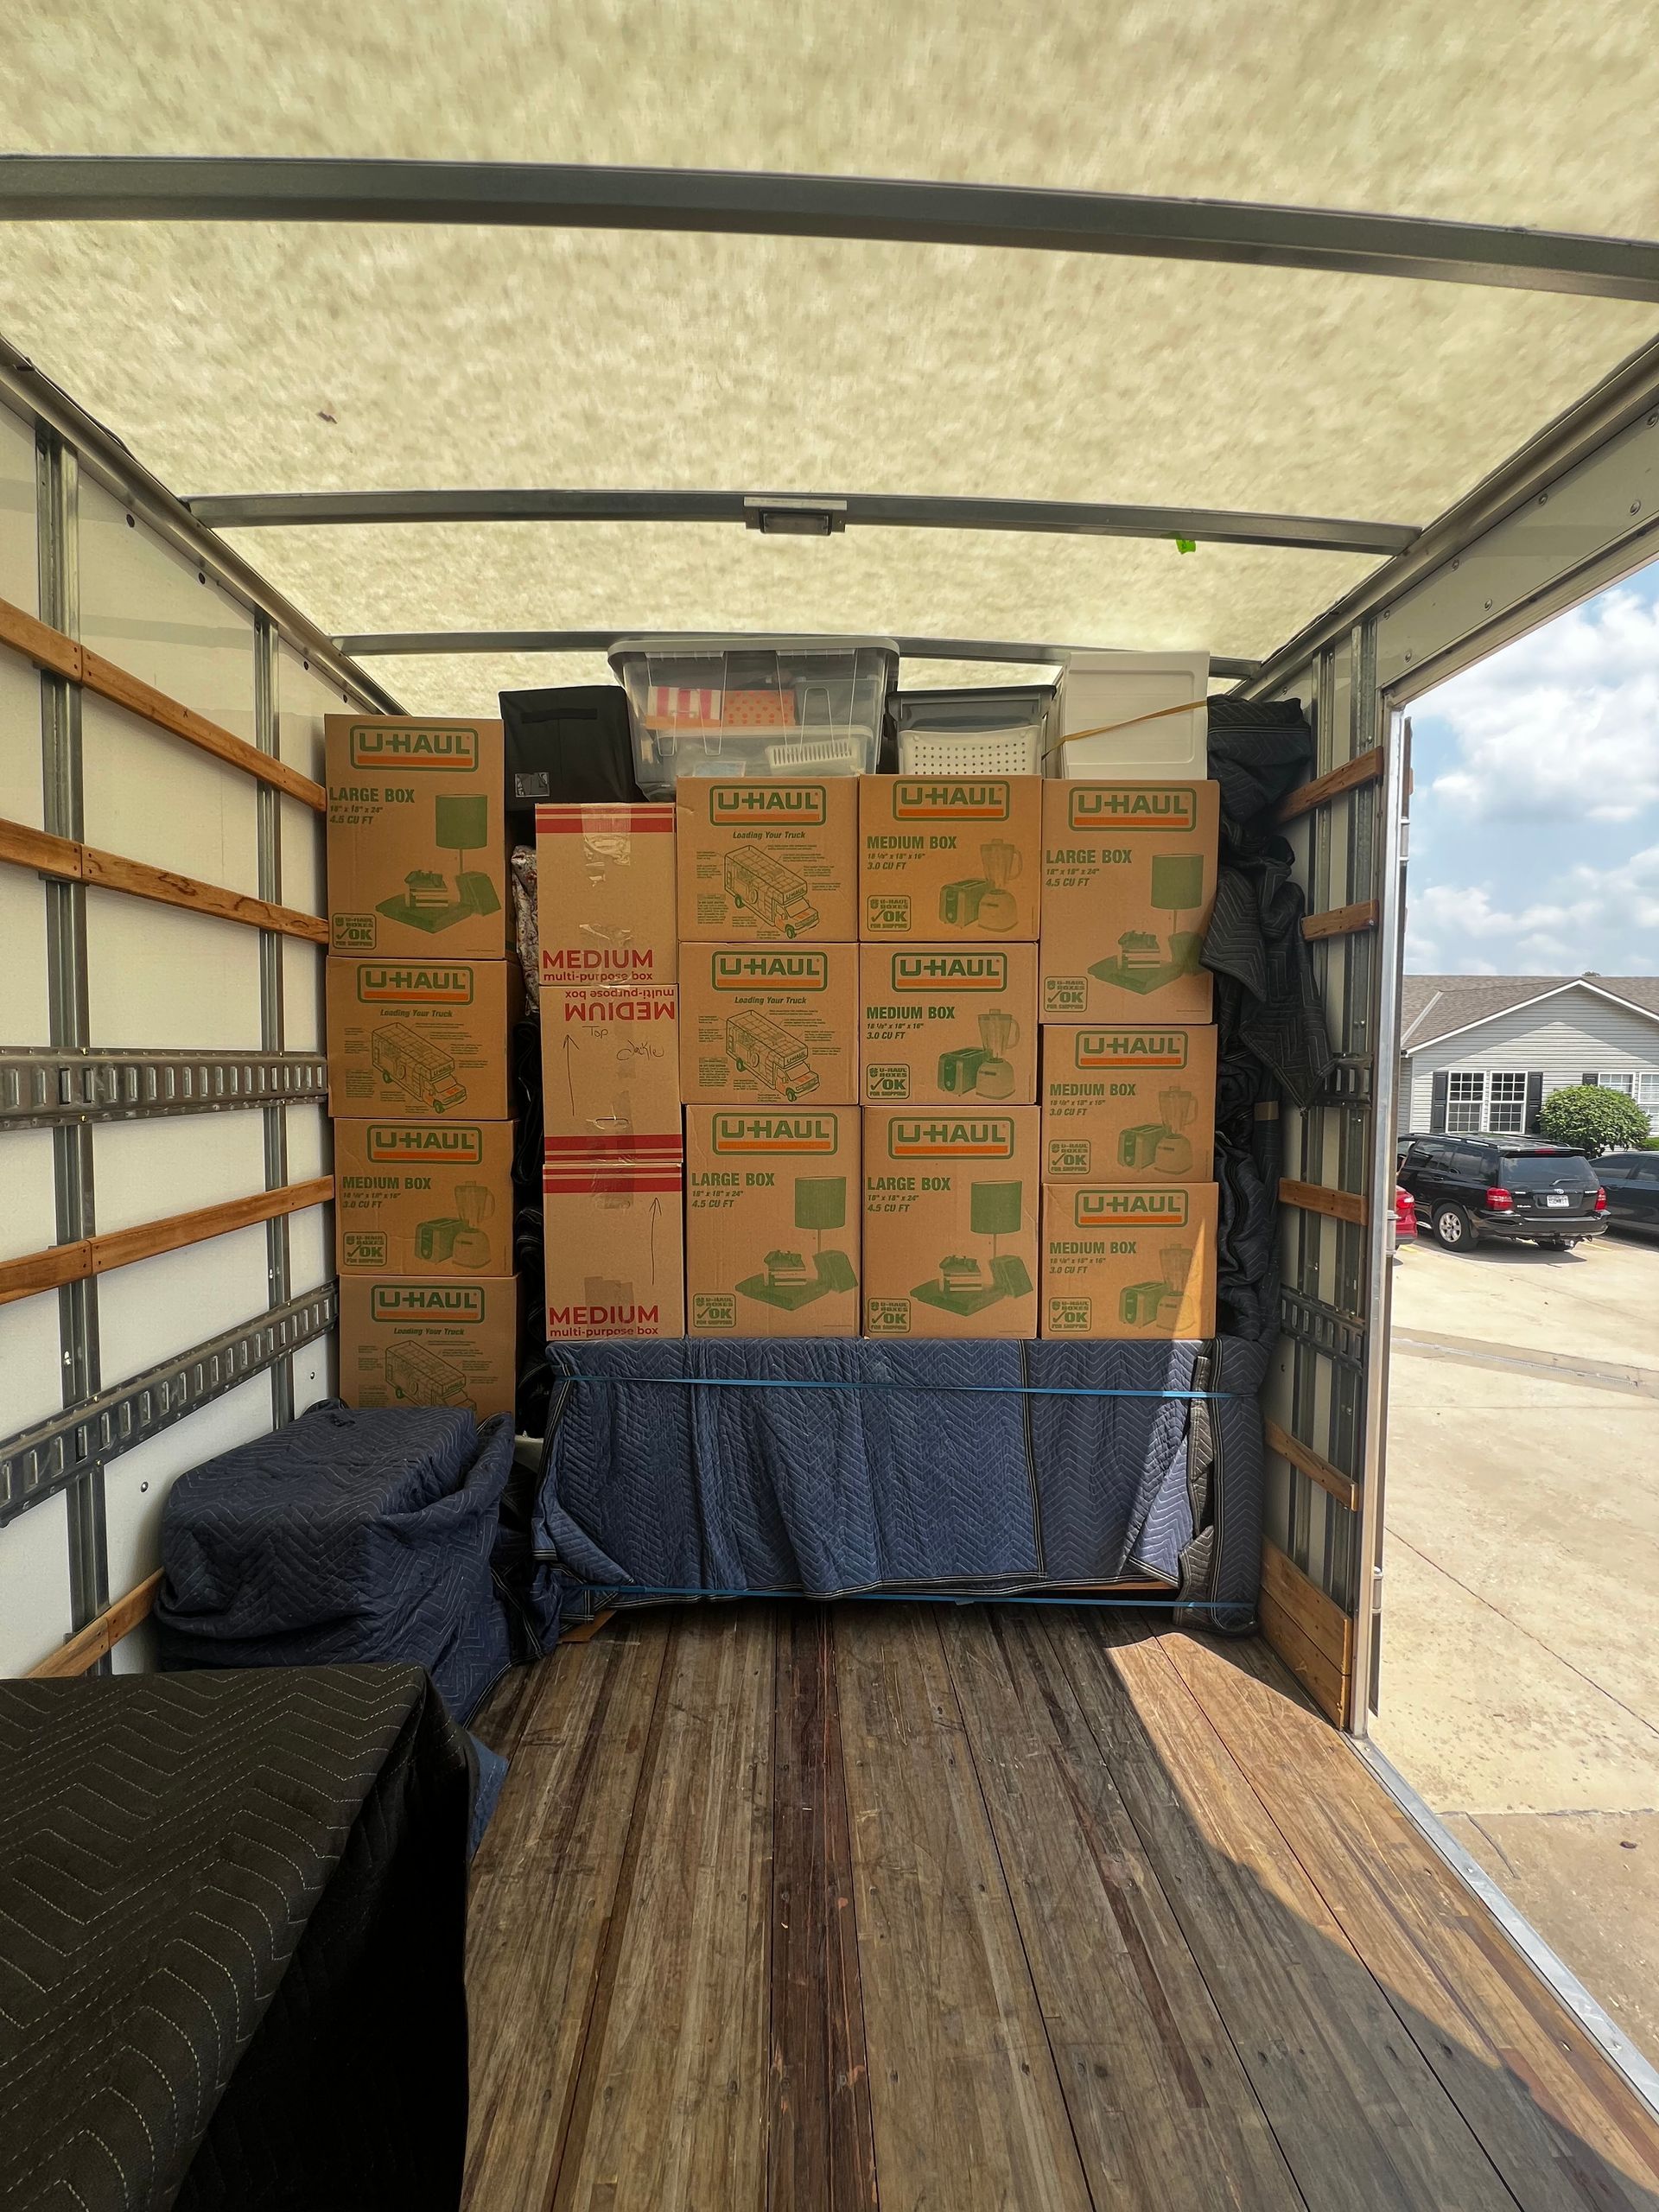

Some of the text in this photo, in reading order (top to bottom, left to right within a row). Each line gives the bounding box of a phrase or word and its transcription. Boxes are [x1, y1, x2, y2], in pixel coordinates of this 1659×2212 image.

[359, 733, 471, 755] U-HAUL
[329, 787, 415, 804] LARGE BOX
[718, 792, 818, 810] U-HAUL
[901, 787, 1002, 805] U-HAUL
[1077, 794, 1189, 814] U-HAUL
[733, 831, 762, 840] Loading
[867, 836, 957, 849] MEDIUM BOX
[1046, 849, 1132, 864] LARGE BOX
[1046, 878, 1090, 887] 4.5 CU FT
[883, 911, 906, 922] OK
[348, 929, 372, 941] OK
[543, 950, 653, 969] MEDIUM
[720, 958, 820, 976] U-HAUL
[899, 959, 1000, 976] U-HAUL
[365, 971, 466, 989] U-HAUL
[543, 971, 653, 982] multi-purpose box
[565, 988, 674, 1000] multi-purpose box
[734, 996, 764, 1005] Loading
[1059, 992, 1084, 1002] OK
[564, 1001, 675, 1021] MEDIUM
[867, 1007, 955, 1020] MEDIUM BOX
[1084, 1038, 1180, 1054] U-HAUL
[882, 1079, 906, 1090] OK
[1050, 1084, 1136, 1096] MEDIUM BOX
[721, 1120, 830, 1139] U-HAUL
[898, 1124, 1006, 1142] U-HAUL
[375, 1132, 474, 1149] U-HAUL
[1064, 1154, 1087, 1166] OK
[343, 1177, 431, 1190] MEDIUM BOX
[692, 1173, 775, 1186] LARGE BOX
[868, 1177, 951, 1191] LARGE BOX
[1083, 1196, 1181, 1213] U-HAUL
[359, 1246, 383, 1258] OK
[1049, 1242, 1136, 1254] MEDIUM BOX
[379, 1291, 478, 1309] U-HAUL
[549, 1305, 659, 1325] MEDIUM
[709, 1308, 732, 1319] OK
[883, 1313, 907, 1324] OK
[1064, 1312, 1087, 1323] OK
[550, 1325, 658, 1338] multi-purpose box
